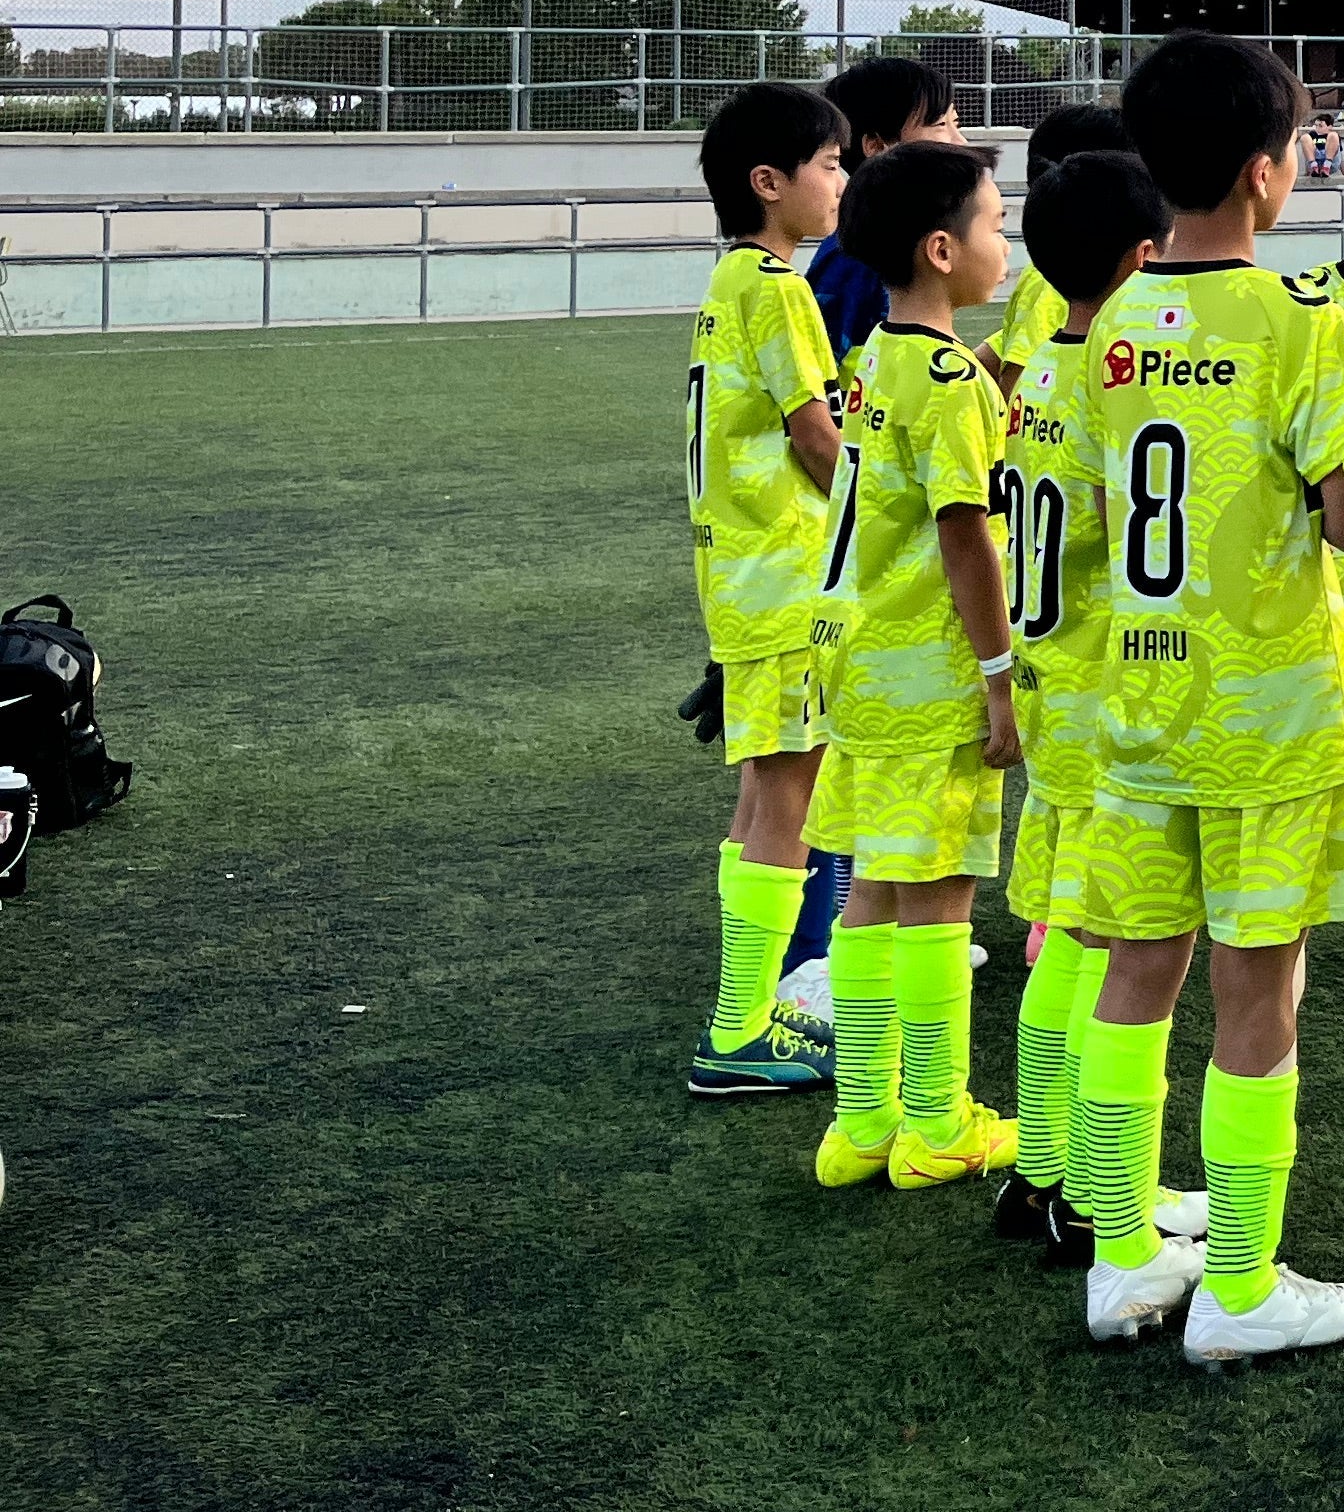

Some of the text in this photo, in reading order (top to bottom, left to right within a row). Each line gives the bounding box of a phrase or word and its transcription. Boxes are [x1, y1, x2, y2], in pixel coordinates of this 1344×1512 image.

[1139, 349, 1236, 387] Piece
[1021, 404, 1065, 445] Piec
[1125, 422, 1187, 599] 8
[1123, 629, 1187, 662] HARU
